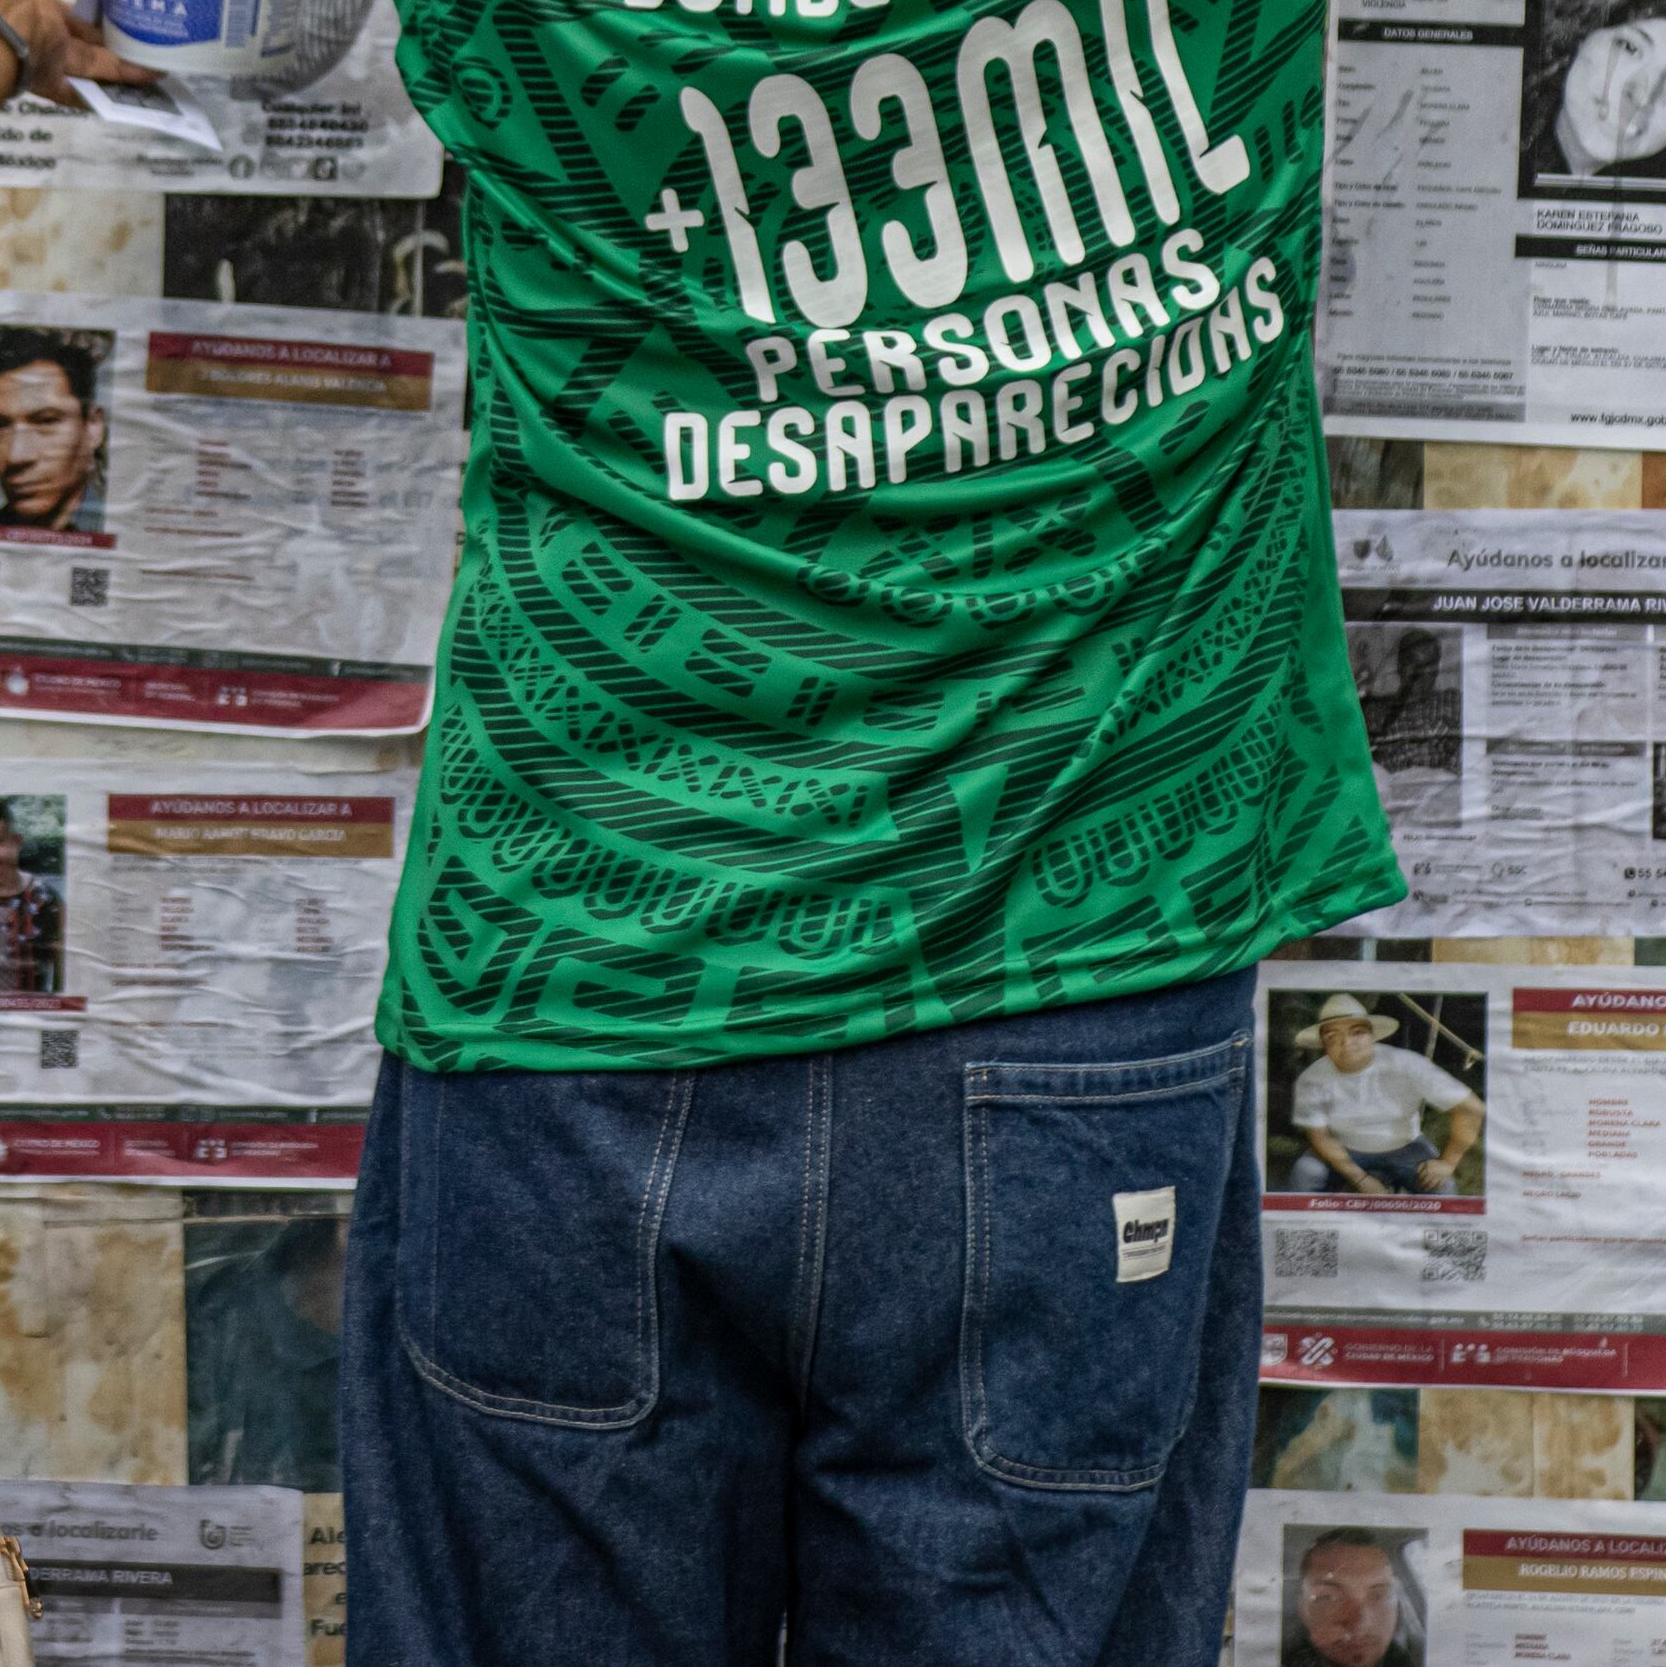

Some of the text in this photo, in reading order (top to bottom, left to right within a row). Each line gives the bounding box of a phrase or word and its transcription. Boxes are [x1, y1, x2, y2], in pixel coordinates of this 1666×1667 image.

[1383, 28, 1473, 41] DATOS GENERALES
[30, 127, 52, 144] de
[1537, 209, 1640, 223] KAREN ESTEFANIA
[1536, 220, 1663, 235] DOMINGUEZ FRAGOSO
[747, 227, 1226, 402] PERSONAS
[665, 257, 1285, 502] DESAPARECIDAS
[1448, 548, 1553, 571] Ayúdanos
[1560, 553, 1574, 568] a
[1433, 595, 1477, 611] JUAN
[1482, 595, 1524, 612] JOSE
[1527, 595, 1641, 613] VALDERRAMA
[1567, 1019, 1661, 1038] EDUARDO
[1505, 1535, 1590, 1554] AYÚDANOS
[1594, 1538, 1607, 1554] A
